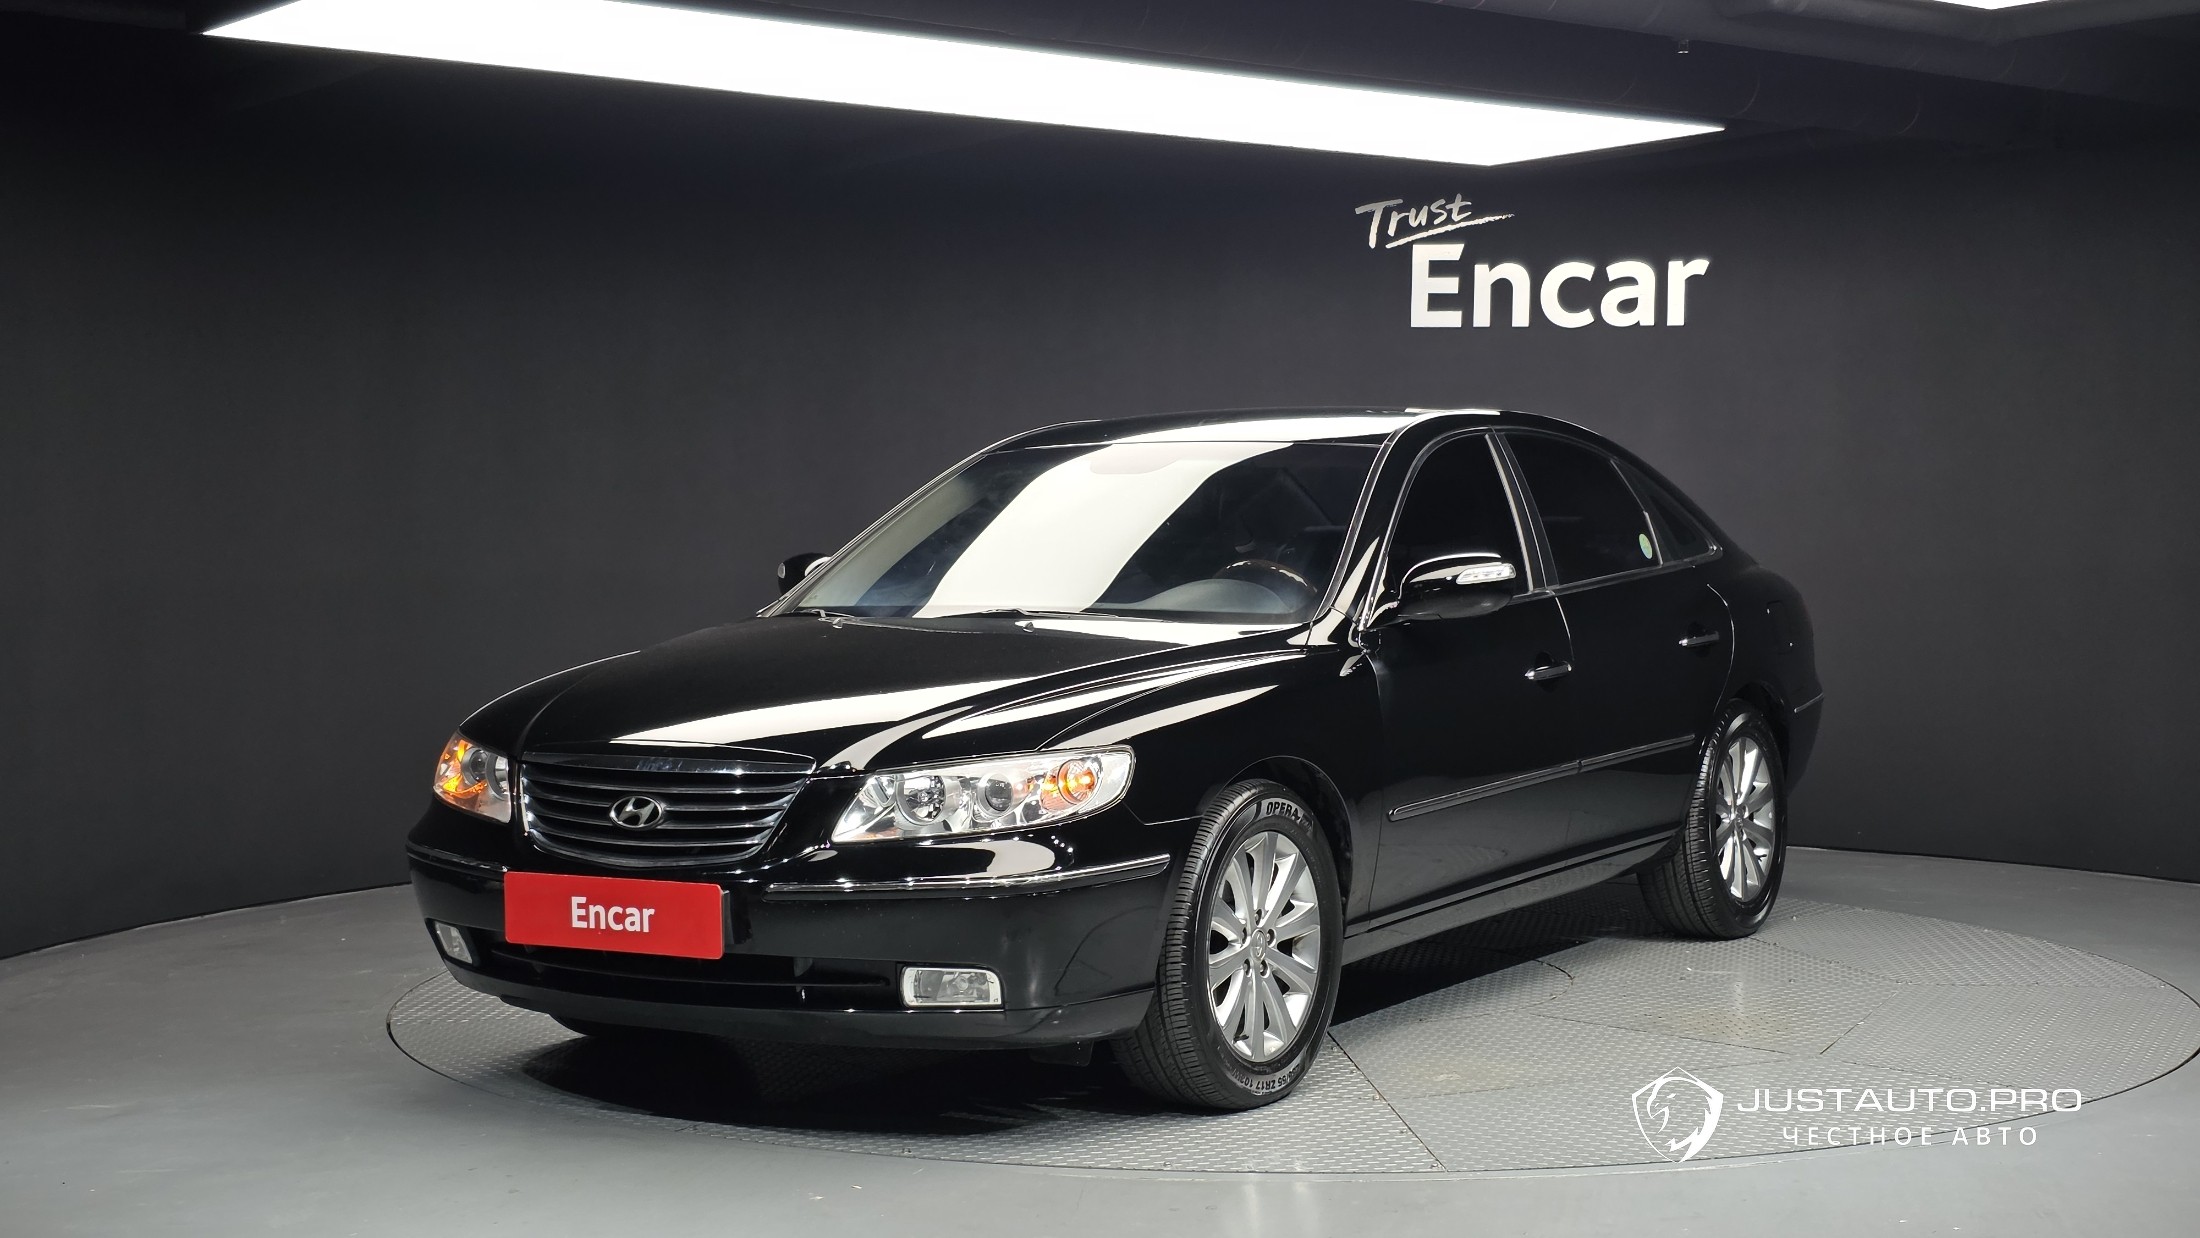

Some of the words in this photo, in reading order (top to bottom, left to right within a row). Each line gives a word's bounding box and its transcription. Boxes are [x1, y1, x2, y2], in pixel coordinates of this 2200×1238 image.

[1355, 193, 1473, 249] Trust
[1410, 243, 1710, 329] Encar
[571, 896, 656, 933] Encar
